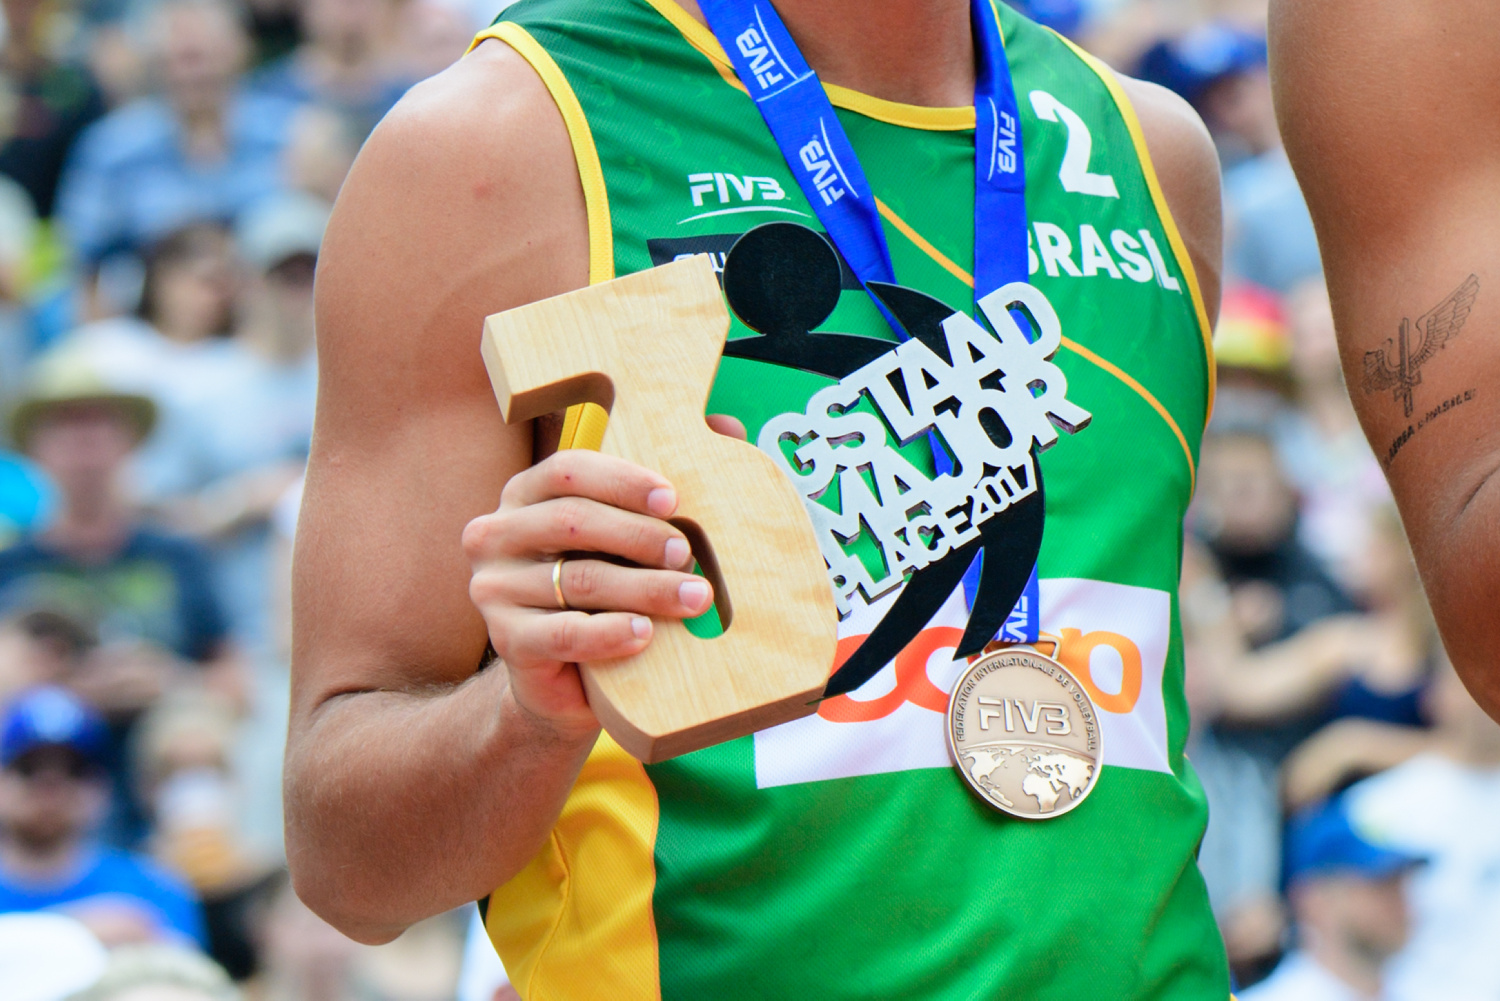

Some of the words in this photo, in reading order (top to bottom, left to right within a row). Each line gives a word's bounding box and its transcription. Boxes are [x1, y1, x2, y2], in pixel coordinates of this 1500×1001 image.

[736, 26, 784, 90] FIVB
[799, 138, 846, 207] FIVB
[998, 110, 1017, 174] FIVB
[1028, 89, 1121, 199] 2
[688, 162, 786, 207] FIVB
[757, 281, 1062, 502] GSTAAD
[800, 358, 1093, 584] MAJOR
[825, 503, 983, 620] PLACE
[962, 461, 1038, 529] 2017
[1004, 595, 1028, 644] FIV
[815, 625, 1143, 724] cop
[974, 656, 1055, 683] INTERNATIONALE
[1055, 671, 1071, 687] DE
[1069, 684, 1097, 752] VOLLEYBALL
[977, 696, 1072, 736] FIVB
